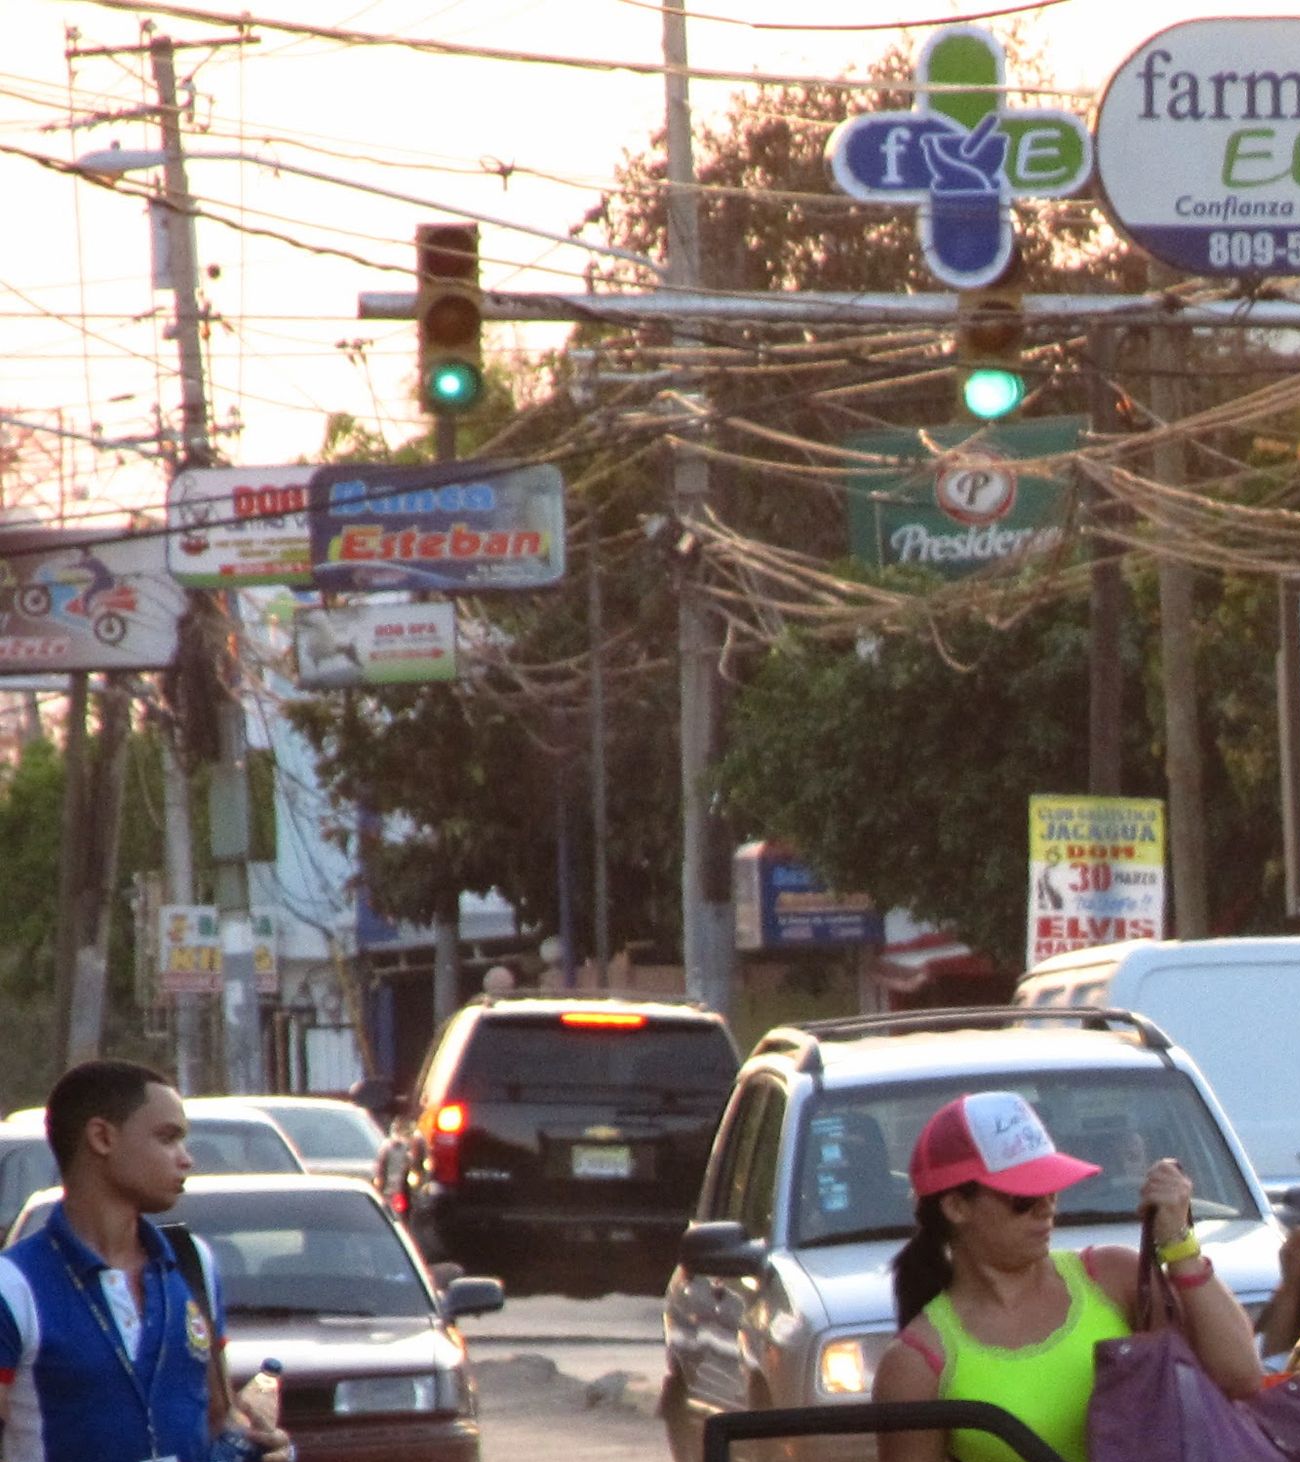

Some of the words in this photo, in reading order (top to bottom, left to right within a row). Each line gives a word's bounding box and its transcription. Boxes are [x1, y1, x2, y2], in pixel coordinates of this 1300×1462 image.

[1175, 195, 1292, 220] Confianza
[340, 523, 544, 561] Esteban
[1038, 916, 1155, 940] ELVIS
